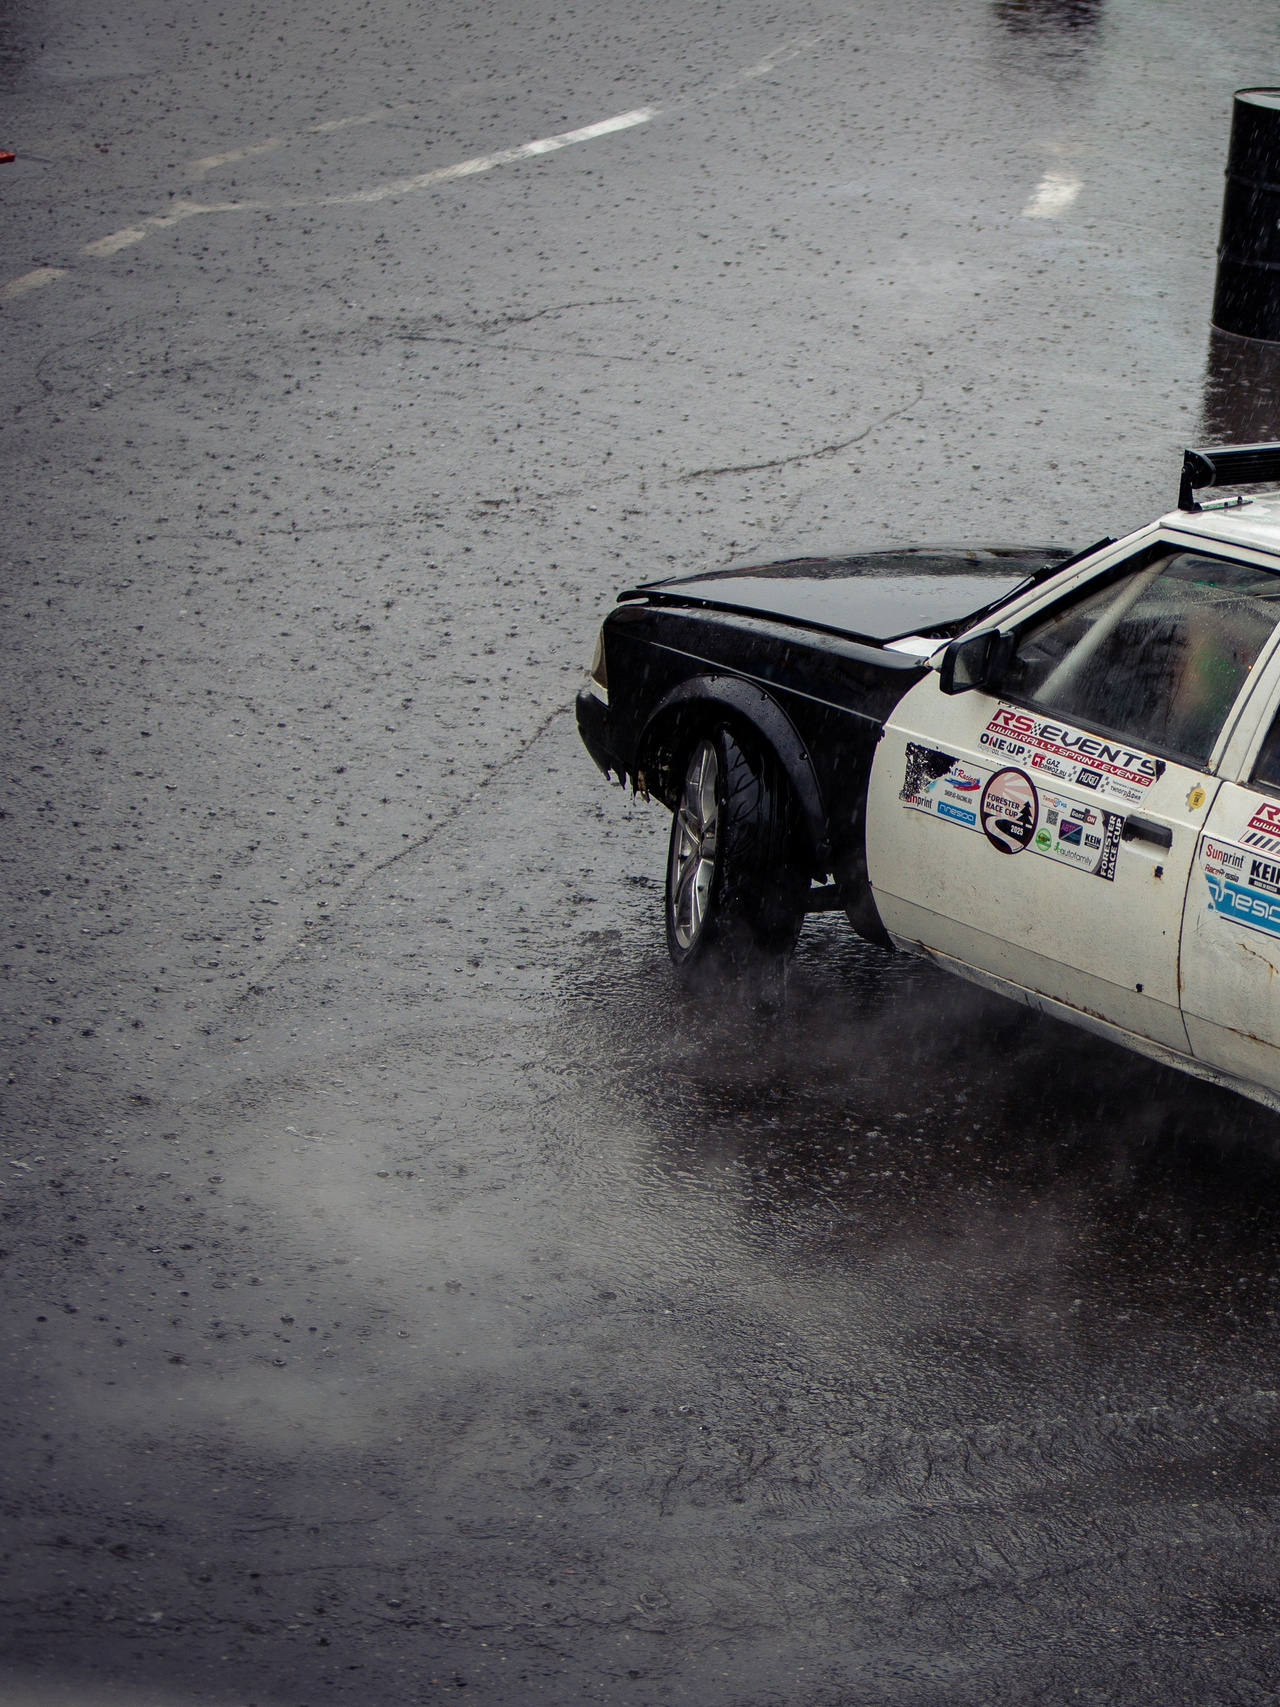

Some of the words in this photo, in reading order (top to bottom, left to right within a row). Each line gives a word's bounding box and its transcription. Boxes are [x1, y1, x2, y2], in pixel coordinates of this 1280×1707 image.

[980, 733, 1007, 751] ONE
[1007, 742, 1026, 756] UP
[992, 709, 1035, 733] RS
[1039, 725, 1157, 777] EVENTS
[1046, 758, 1061, 768] GAZ
[986, 801, 1004, 813] RACE
[1004, 808, 1019, 818] CUP
[987, 793, 1020, 811] FORESTER
[1010, 825, 1024, 836] 2025
[1085, 833, 1102, 846] KEIN
[1101, 815, 1117, 876] FORESTER
[1107, 846, 1118, 879] RACE
[1113, 818, 1123, 843] CUP
[1060, 848, 1093, 867] autofamily
[1206, 843, 1245, 869] Sunprint
